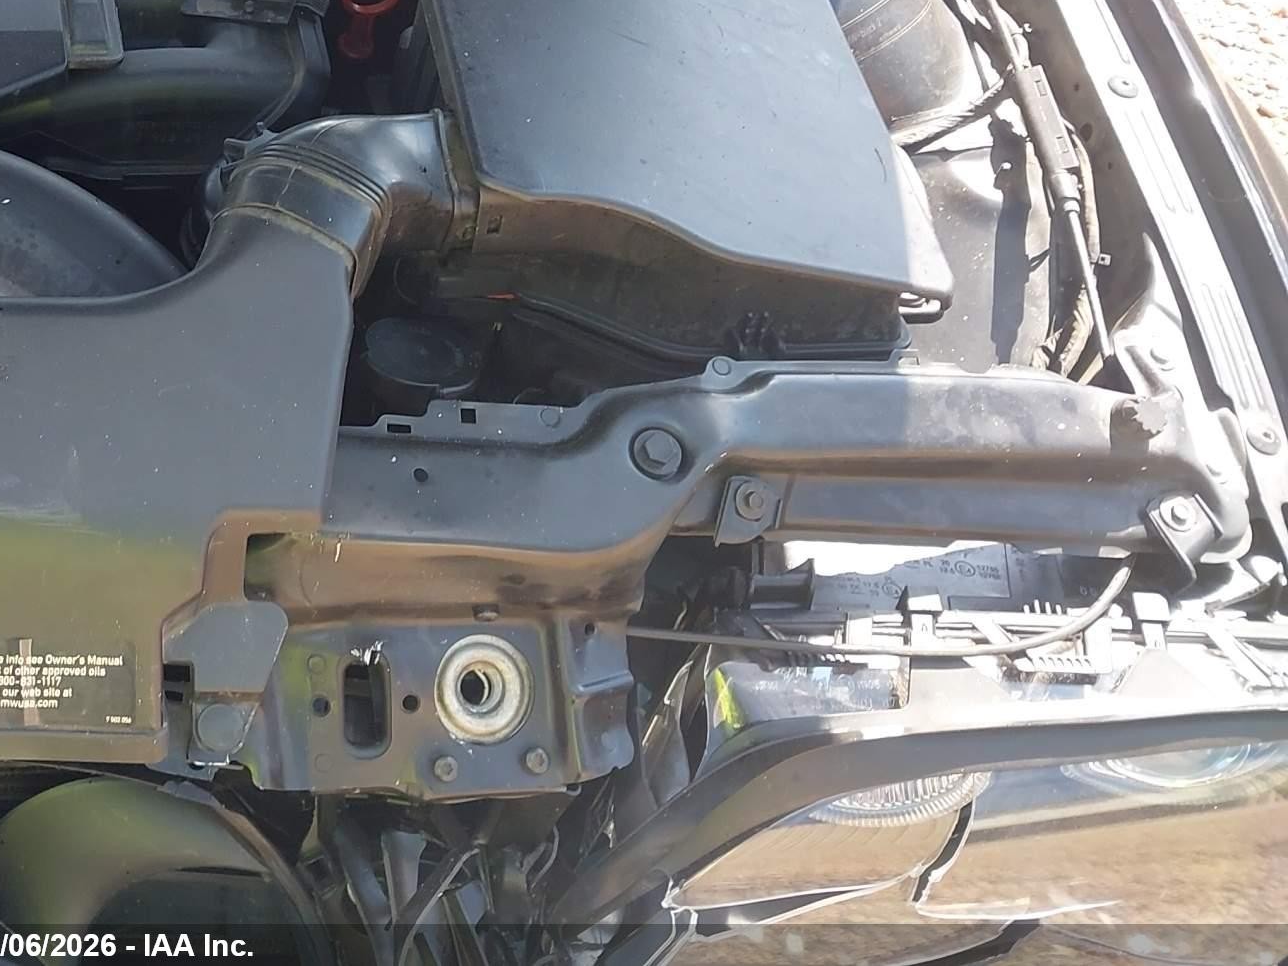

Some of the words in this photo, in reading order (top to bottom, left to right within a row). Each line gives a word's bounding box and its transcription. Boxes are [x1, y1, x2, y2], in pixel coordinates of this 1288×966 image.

[26, 655, 43, 665] see
[45, 654, 85, 665] Owner's
[87, 654, 123, 666] Manual
[3, 665, 13, 675] of
[14, 665, 39, 676] other
[42, 665, 86, 678] approved
[88, 665, 106, 677] oils
[2, 688, 19, 697] our
[21, 687, 40, 698] web
[43, 687, 61, 698] site
[62, 687, 73, 697] at
